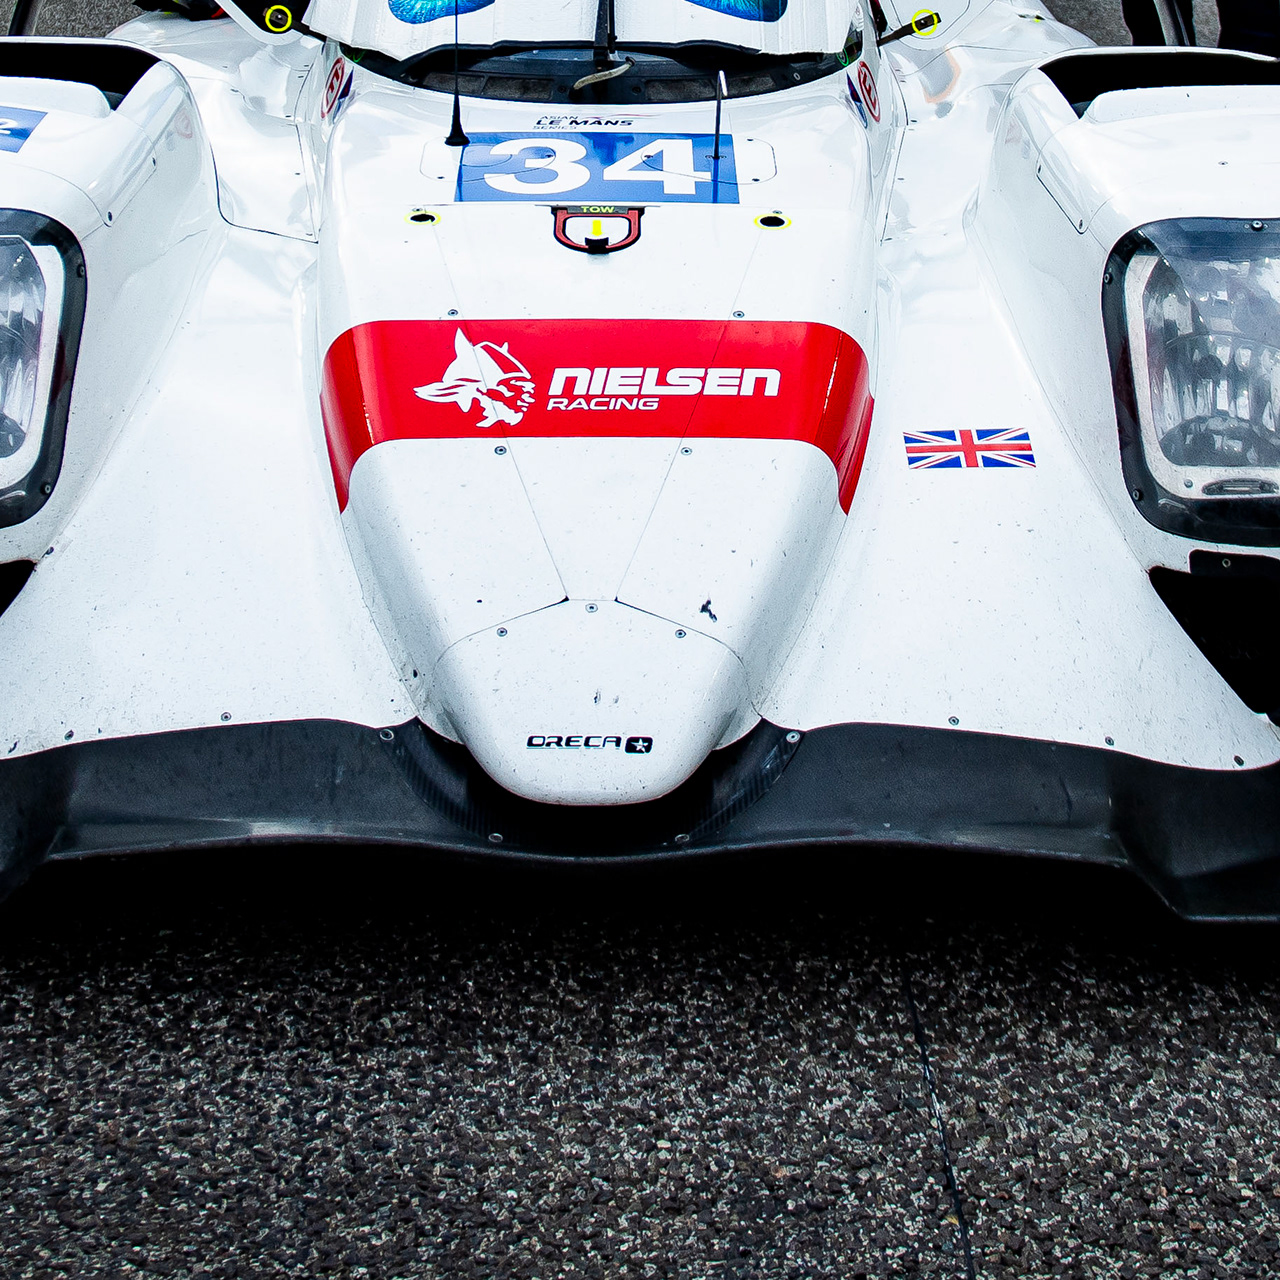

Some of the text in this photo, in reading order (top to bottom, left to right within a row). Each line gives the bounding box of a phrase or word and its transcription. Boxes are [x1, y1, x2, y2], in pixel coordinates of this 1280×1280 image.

[483, 138, 712, 195] 34
[548, 367, 781, 396] NIELSEN
[546, 397, 660, 411] RACING
[526, 735, 622, 748] ORECA
